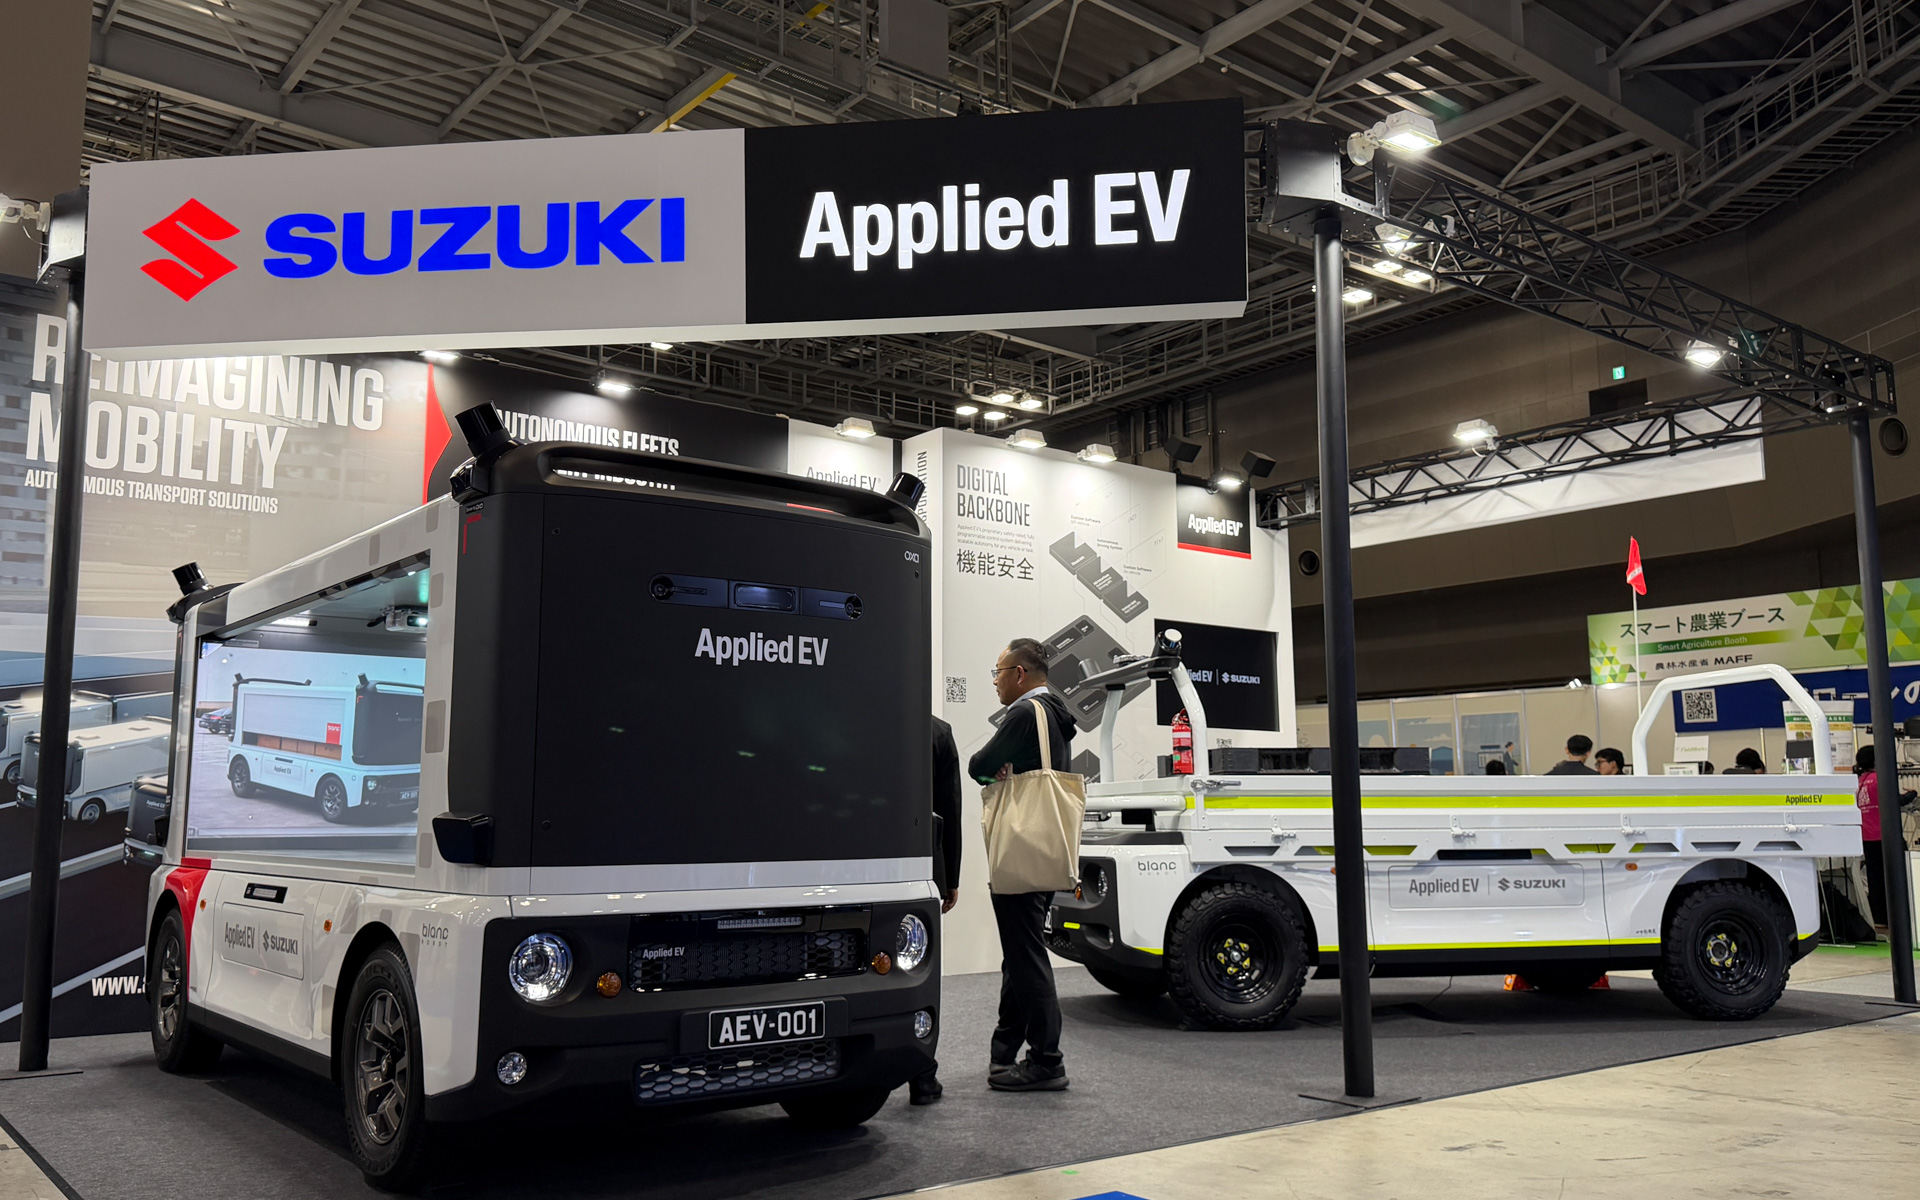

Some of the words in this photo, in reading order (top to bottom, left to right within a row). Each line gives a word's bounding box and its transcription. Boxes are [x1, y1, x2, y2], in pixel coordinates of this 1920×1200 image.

[800, 178, 1070, 271] Applied
[1094, 168, 1191, 245] EV
[263, 197, 685, 279] SUZUKI
[957, 464, 1008, 495] DIGITAL
[127, 480, 205, 506] TRANSPORT
[208, 486, 279, 514] SOLUTIONS
[957, 492, 1030, 526] BACKBONE
[1188, 513, 1226, 534] Applied
[956, 548, 1035, 581] 機能安全
[1620, 607, 1785, 638] スマート農業ブース
[694, 627, 794, 667] Applied
[798, 635, 829, 666] EV
[1657, 643, 1680, 652] Smart
[1681, 638, 1723, 651] Agriculture
[1724, 636, 1748, 645] Booth
[1202, 669, 1213, 683] EV
[1230, 674, 1260, 685] SUZUKI
[1655, 657, 1709, 671] 農林水産省
[1713, 654, 1753, 666] MAFF
[1785, 794, 1813, 806] Applied
[1813, 794, 1823, 803] EV
[1137, 860, 1177, 871] blanc
[1408, 878, 1460, 897] Applied
[1462, 877, 1480, 893] EV
[1513, 878, 1566, 890] SUZUKI
[224, 921, 246, 949] Applied
[246, 926, 256, 949] EV
[270, 936, 299, 955] SUZUKI
[421, 922, 449, 940] blanc
[643, 947, 673, 960] Applied
[674, 946, 685, 956] EV
[719, 1008, 816, 1044] AEV-001
